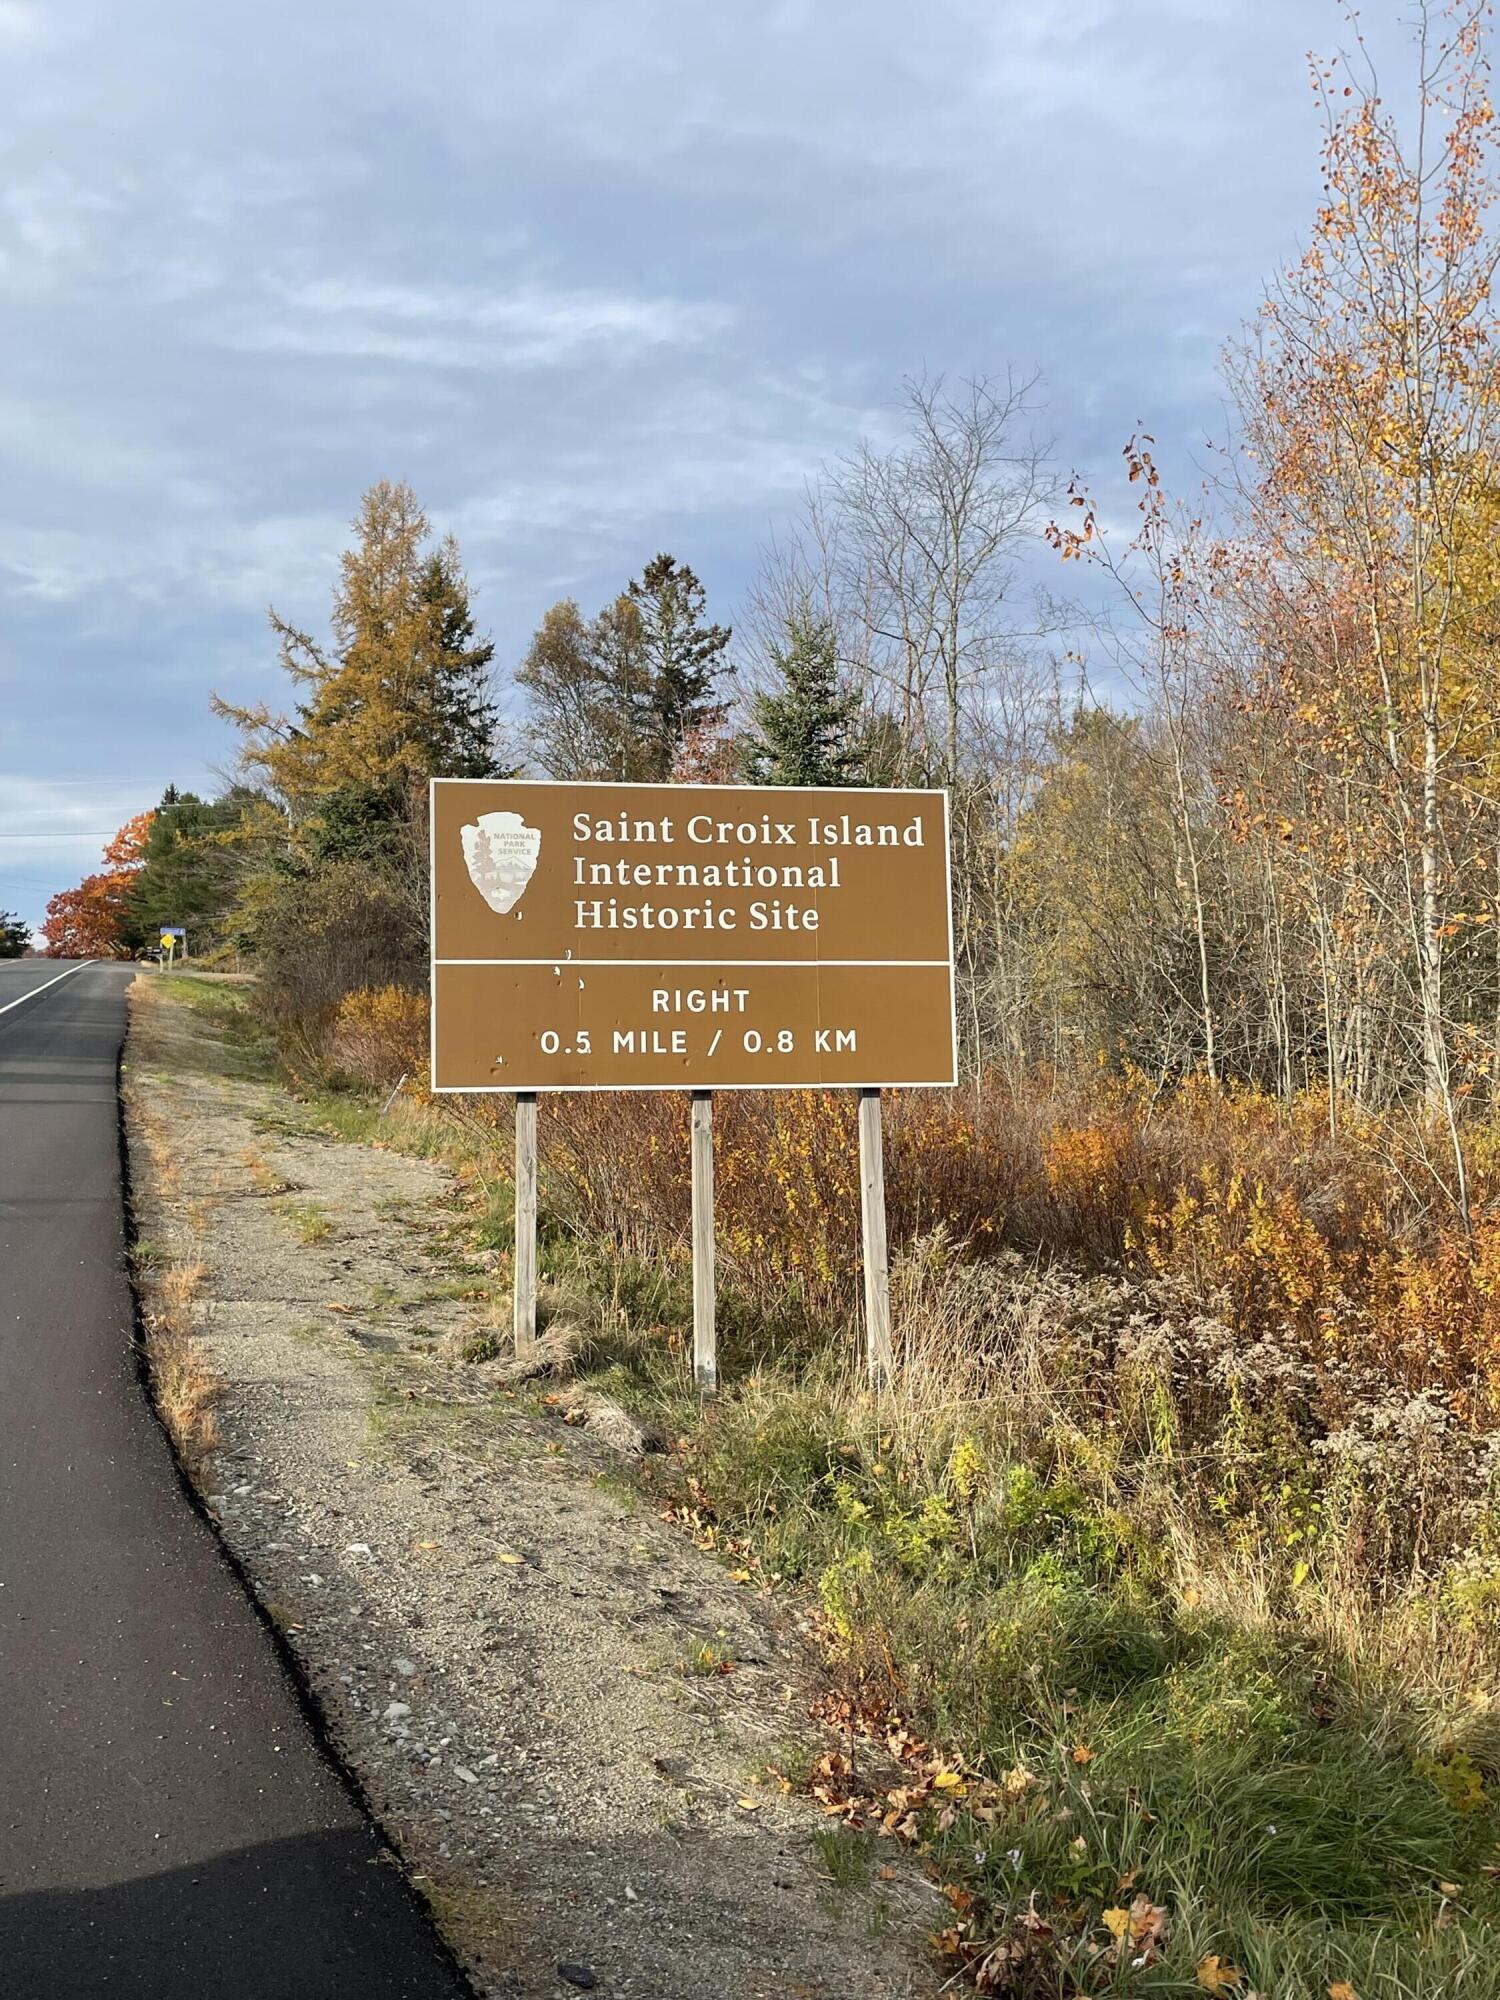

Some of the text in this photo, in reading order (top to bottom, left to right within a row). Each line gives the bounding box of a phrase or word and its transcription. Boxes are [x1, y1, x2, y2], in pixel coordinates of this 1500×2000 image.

[574, 812, 924, 846] Saint Croix Island
[574, 857, 840, 887] International
[575, 899, 819, 930] Historic Site
[653, 990, 749, 1012] RIGHT
[541, 1030, 856, 1056] 0.5 MILE / 0.8 KM
